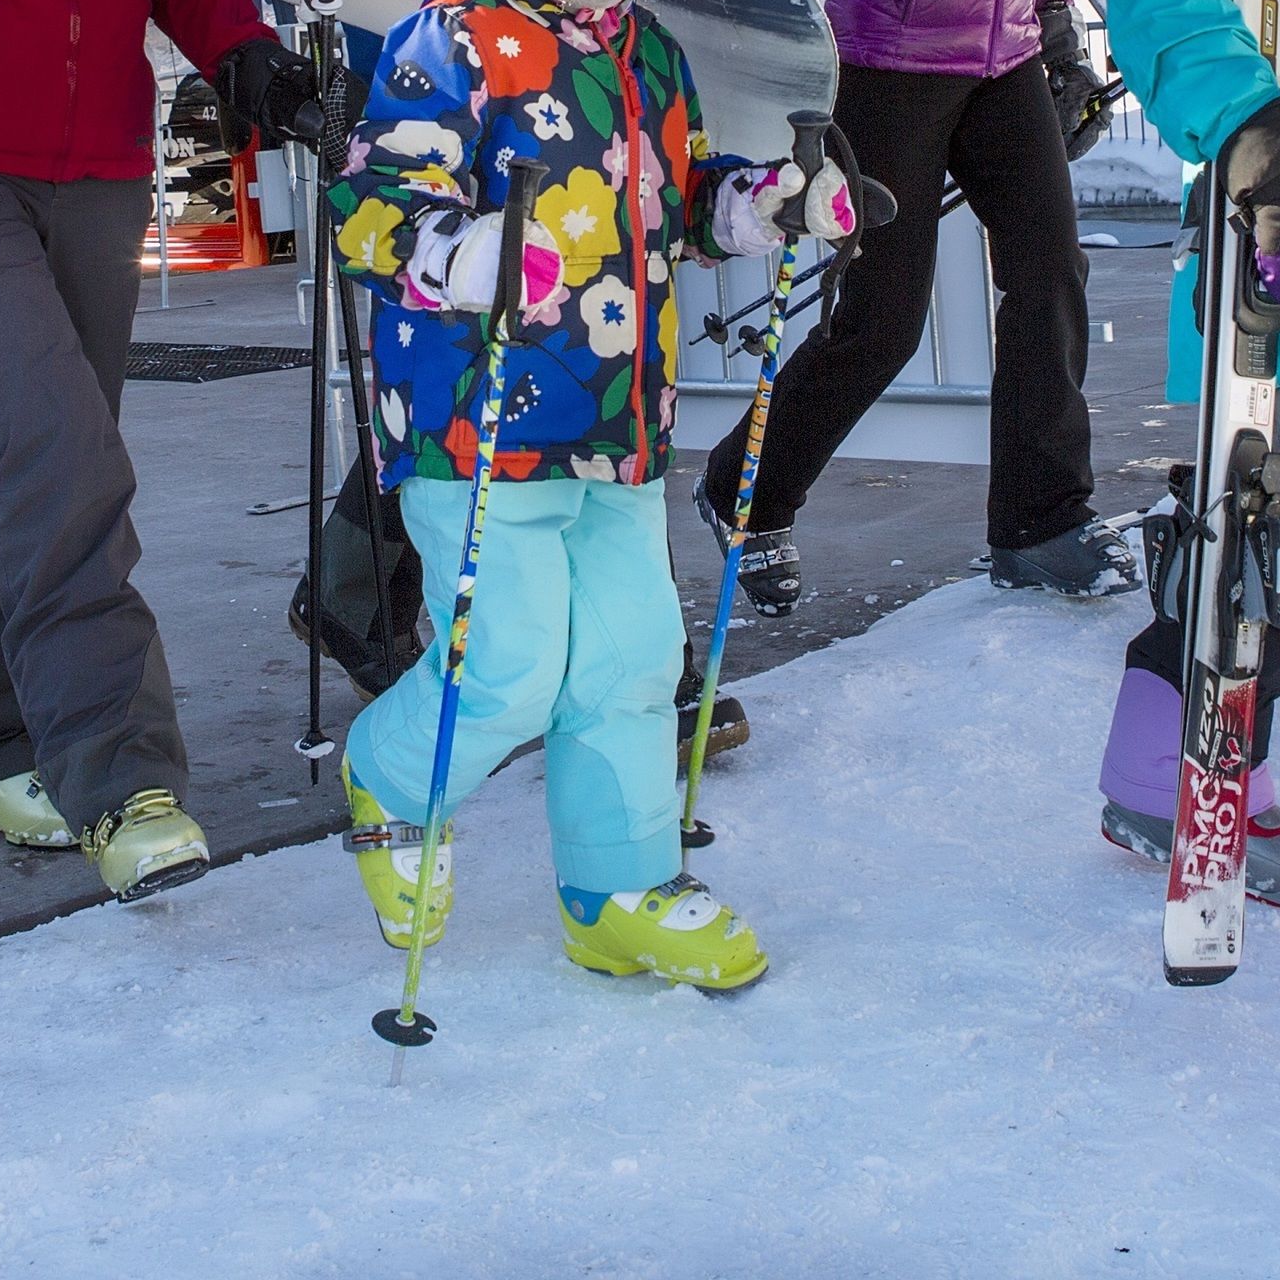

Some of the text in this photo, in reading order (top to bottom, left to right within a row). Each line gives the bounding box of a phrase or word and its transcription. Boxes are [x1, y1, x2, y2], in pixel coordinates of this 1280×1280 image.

[202, 106, 218, 121] 42
[1198, 676, 1216, 756] 120
[1181, 774, 1221, 885] PMC
